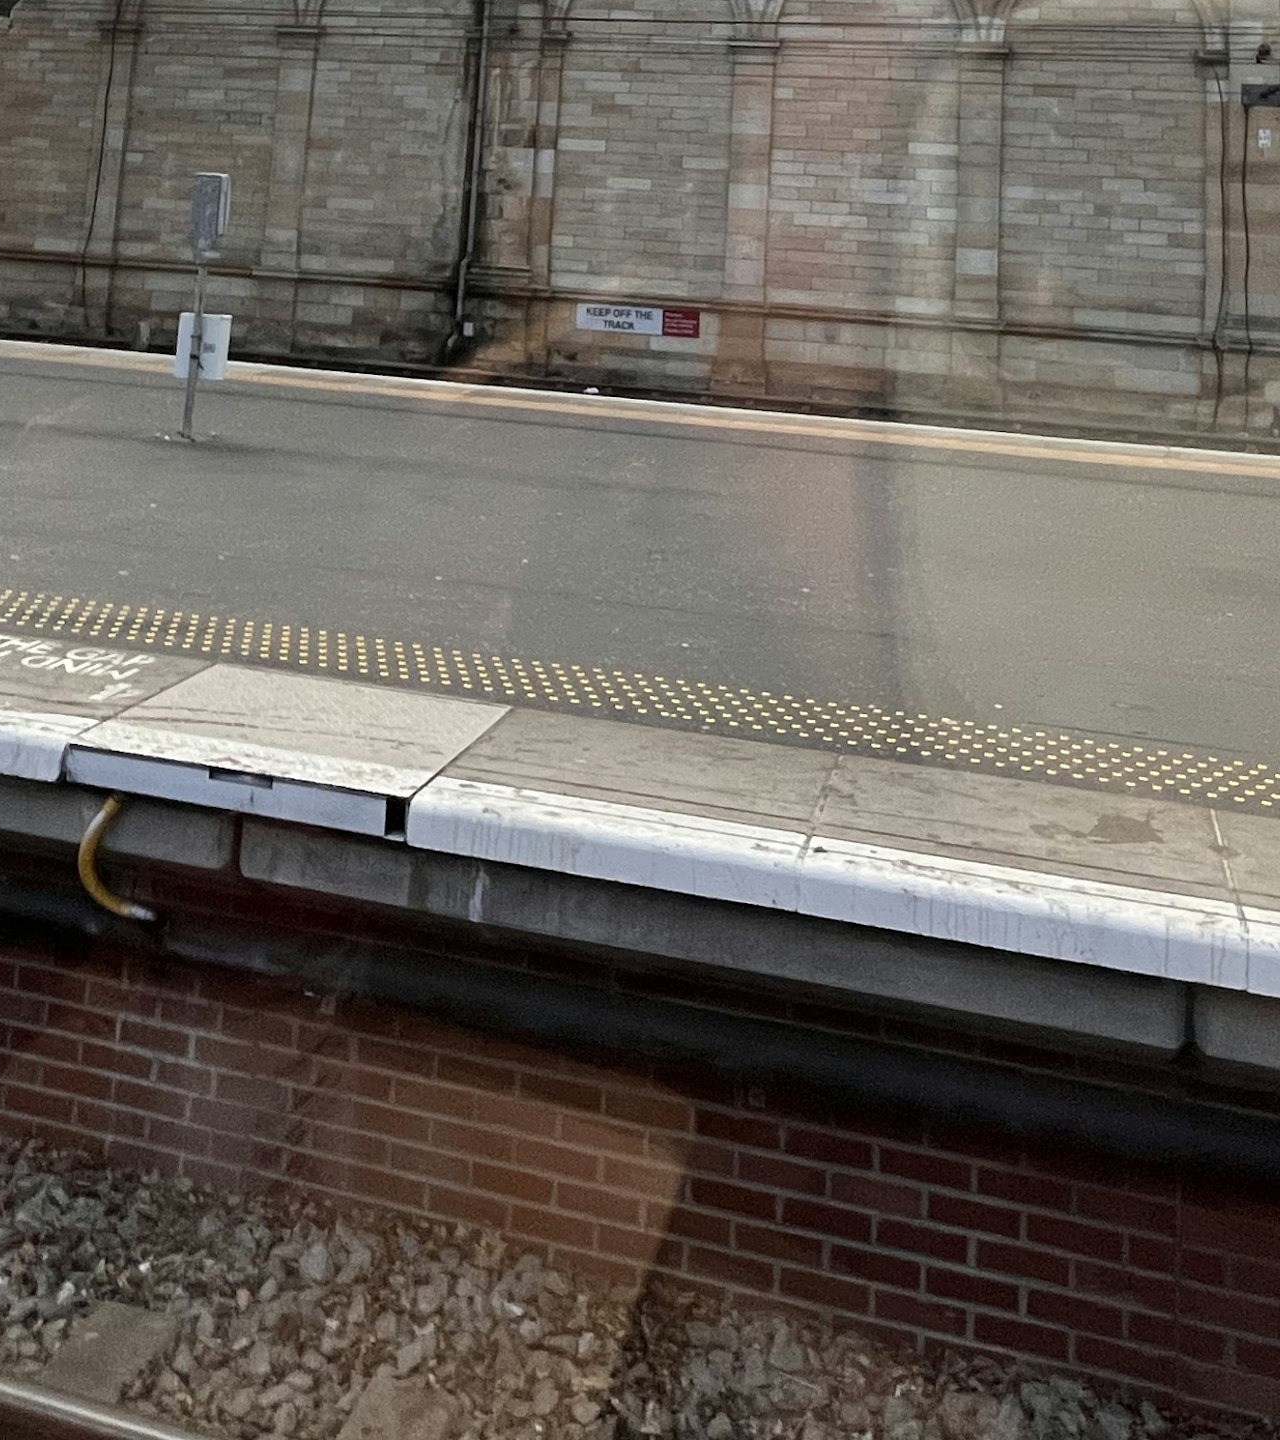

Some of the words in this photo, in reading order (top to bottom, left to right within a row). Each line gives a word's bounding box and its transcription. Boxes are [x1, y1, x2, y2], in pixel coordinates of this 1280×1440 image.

[586, 307, 611, 317] KEEP
[613, 309, 632, 318] OFF
[635, 310, 653, 320] THE
[603, 320, 635, 330] TRACK
[66, 647, 156, 667] GAP
[21, 655, 140, 680] MIND
